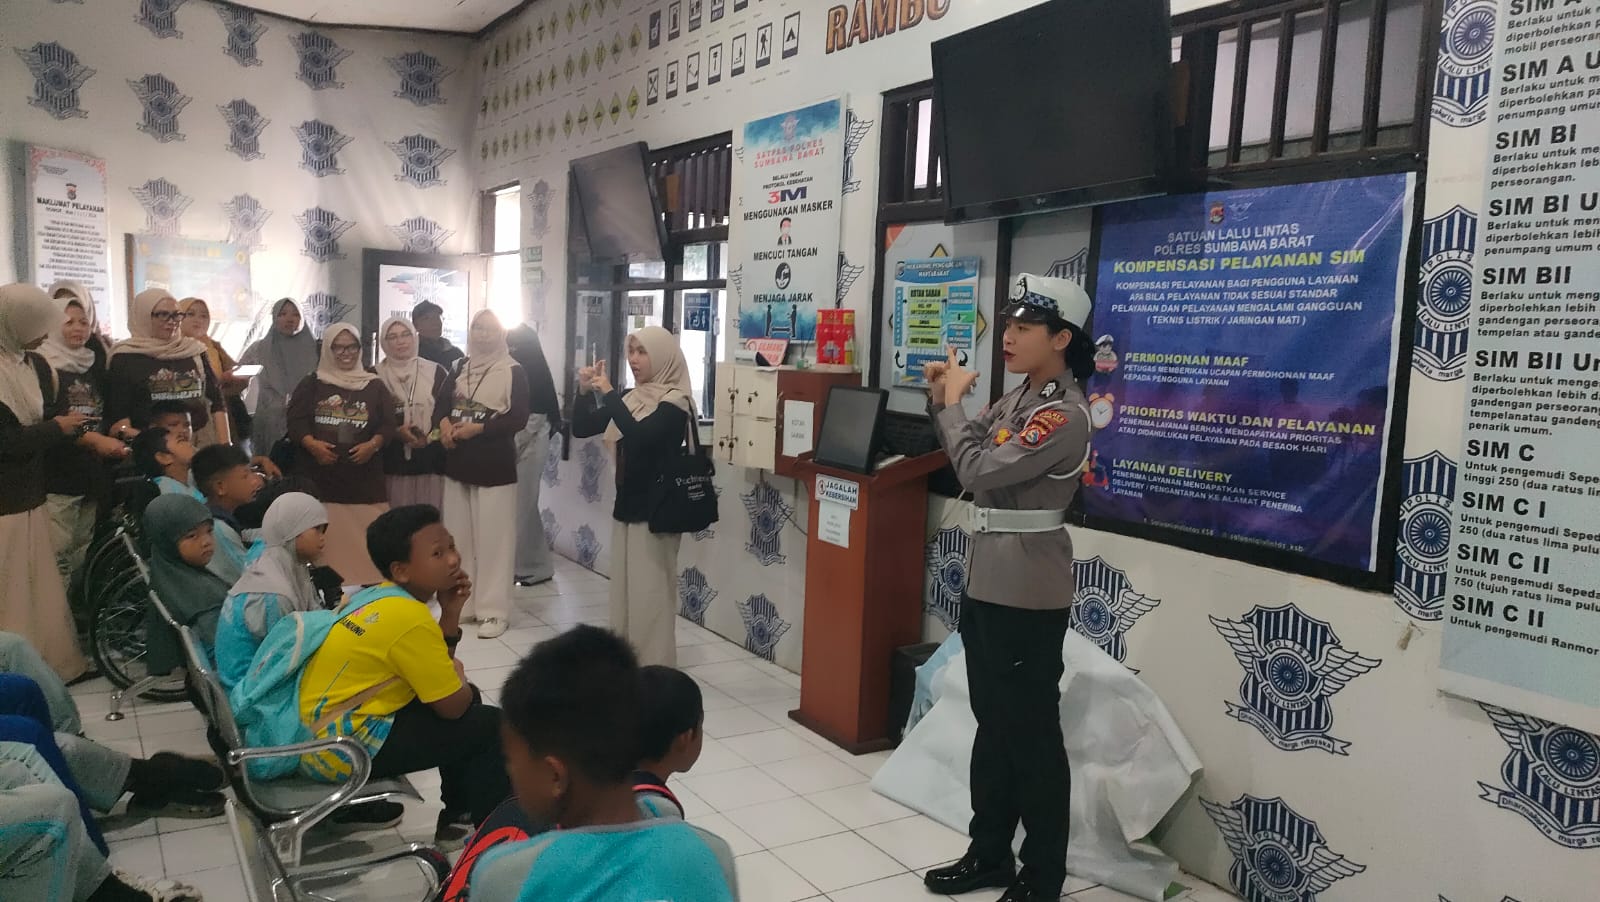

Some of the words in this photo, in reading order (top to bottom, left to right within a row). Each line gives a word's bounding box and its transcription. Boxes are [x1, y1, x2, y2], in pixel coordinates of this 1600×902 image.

[1507, 15, 1553, 29] Berlaku
[1557, 6, 1592, 20] untuk
[1506, 21, 1591, 42] diperbolehkan
[1504, 41, 1537, 55] mobil
[1502, 58, 1548, 82] SIM
[1556, 55, 1574, 74] A
[1500, 82, 1546, 96] Berlaku
[1549, 75, 1585, 89] untuk
[1498, 89, 1584, 109] diperbolehkan
[1497, 105, 1566, 123] penumpang
[1495, 127, 1541, 150] SIM
[1550, 123, 1577, 144] BI
[1493, 150, 1539, 163] Berlaku
[1542, 146, 1577, 159] untuk
[1491, 160, 1577, 177] diperbolehkan
[1490, 173, 1577, 190] perseorangan.
[768, 185, 808, 205] 3M
[37, 197, 71, 209] MAKLUMAT
[72, 201, 105, 213] PELAYANAN
[743, 205, 799, 221] MENGGUNAKAN
[800, 200, 833, 213] MASKER
[1488, 196, 1534, 217] SIM
[1543, 194, 1570, 214] BI
[1167, 229, 1216, 243] SATUAN
[1218, 227, 1251, 240] LALU
[1254, 223, 1300, 237] LINTAS
[1487, 219, 1532, 231] Berlaku
[1535, 217, 1569, 228] untuk
[1154, 243, 1201, 256] POLRES
[1204, 239, 1267, 253] SUMBAWA
[1269, 235, 1315, 249] BARAT
[1485, 230, 1569, 245] diperbolehkan
[753, 250, 785, 261] MENCUCI
[787, 247, 818, 258] TANGAN
[1484, 245, 1551, 257] penumpang
[1555, 243, 1593, 252] umum
[1113, 258, 1215, 273] KOMPENSASI
[1220, 252, 1323, 270] PELAYANAN
[1329, 249, 1365, 265] SIM
[1115, 281, 1170, 291] KOMPENSASI
[1171, 279, 1225, 289] PELAYANAN
[1227, 278, 1249, 288] BAGI
[1251, 277, 1306, 287] PENGGUNA
[1308, 274, 1359, 285] LAYANAN
[1482, 267, 1527, 285] SIM
[1535, 265, 1572, 285] BII
[753, 294, 786, 303] MENJAGA
[788, 292, 813, 302] JARAK
[1167, 292, 1220, 301] PELAYANAN
[1223, 291, 1250, 301] TIDAK
[1251, 290, 1286, 300] SESUAI
[1288, 288, 1339, 298] STANDAR
[1480, 291, 1524, 300] Berlaku
[1528, 290, 1562, 300] untuk
[1111, 304, 1159, 313] PELAYANAN
[1160, 304, 1180, 313] DAN
[1181, 304, 1235, 313] PELAYANAN
[1237, 303, 1294, 313] MENGALAMI
[1296, 301, 1363, 312] GANGGUAN
[1479, 303, 1562, 314] diperbolehkan
[1565, 303, 1596, 313] lebih
[1186, 315, 1220, 325] LISTRIK
[1227, 315, 1275, 325] JARINGAN
[1277, 315, 1301, 325] MATI
[1478, 315, 1541, 327] gandengan
[1477, 328, 1530, 338] tempelan
[1533, 328, 1560, 338] atau
[1124, 352, 1210, 366] PERMOHONAN
[1213, 355, 1249, 367] MAAF
[1475, 349, 1519, 368] SIM
[1527, 351, 1563, 370] BII
[1123, 373, 1151, 382] KEPADA
[1152, 375, 1194, 385] PENGGUNA
[1195, 379, 1230, 387] LAYANAN
[1124, 364, 1156, 373] PETUGAS
[1158, 366, 1209, 375] MEMBERIKAN
[1210, 368, 1241, 377] UCAPAN
[1241, 369, 1306, 380] PERMOHONAN
[1308, 372, 1335, 381] MAAF
[1473, 373, 1516, 383] Berlaku
[1520, 375, 1554, 385] untuk
[1471, 385, 1553, 398] diperbolehkan
[1557, 389, 1587, 400] lebih
[1470, 398, 1532, 410] gandengan
[1119, 404, 1184, 420] PRIORITAS
[1187, 410, 1237, 425] WAKTU
[1277, 418, 1376, 436] PELAYANAN
[1470, 409, 1548, 423] tempelanatau
[1119, 417, 1155, 428] PENERIMA
[1156, 420, 1189, 431] LAYANAN
[1190, 424, 1223, 434] BERHAK
[1225, 427, 1288, 440] MENDAPATKAN
[1289, 432, 1343, 445] PRIORITAS
[1468, 422, 1510, 432] penarik
[1514, 426, 1552, 436] umum.
[1118, 426, 1136, 435] ATAU
[1190, 433, 1238, 446] PELAYANAN
[1239, 438, 1261, 448] PADA
[1302, 445, 1327, 454] HARI
[1467, 439, 1510, 459] SIM
[1519, 444, 1535, 461] C
[1112, 458, 1166, 475] LAYANAN
[1168, 466, 1233, 484] DELIVERY
[1465, 461, 1498, 473] Untuk
[1501, 466, 1565, 480] pengemudi
[826, 481, 857, 495] JAGALAH
[1112, 470, 1147, 482] PENERIMA
[1148, 475, 1182, 487] LAYANAN
[1183, 480, 1246, 495] MENDAPATKAN
[1248, 488, 1288, 500] SERVICE
[1112, 488, 1144, 499] LAYANAN
[1464, 473, 1495, 485] tinggi
[1498, 477, 1519, 487] 250
[1522, 480, 1548, 490] (dua
[1552, 484, 1584, 495] ratus
[825, 491, 857, 504] KEBERSIHAN
[1112, 478, 1145, 491] DELIVERY
[1150, 485, 1207, 500] PENGANTARAN
[1208, 492, 1220, 502] KE
[1222, 495, 1259, 507] ALAMAT
[1260, 500, 1304, 514] PENERIMA
[1462, 492, 1505, 512] SIM
[1513, 498, 1530, 516] C
[1539, 501, 1546, 518] I
[1460, 513, 1493, 526] Untuk
[1495, 520, 1559, 536] pengemudi
[1459, 525, 1479, 536] 250
[1482, 528, 1506, 540] (dua
[1509, 534, 1540, 545] ratus
[1543, 537, 1569, 550] lima
[1457, 543, 1499, 566] SIM
[1508, 552, 1524, 569] C
[1533, 555, 1550, 575] II
[1455, 565, 1487, 578] Untuk
[1490, 573, 1554, 591] pengemudi
[1454, 576, 1474, 588] 750
[1476, 580, 1509, 594] (tujuh
[1512, 588, 1542, 601] ratus
[1546, 594, 1572, 607] lima
[1452, 594, 1494, 618] SIM
[1502, 604, 1519, 623] C
[1528, 609, 1545, 628] II
[1450, 615, 1482, 630] Untuk
[1485, 623, 1548, 644] pengemudi
[1551, 637, 1600, 656] Ranmor
[1537, 766, 1561, 790] LALU
